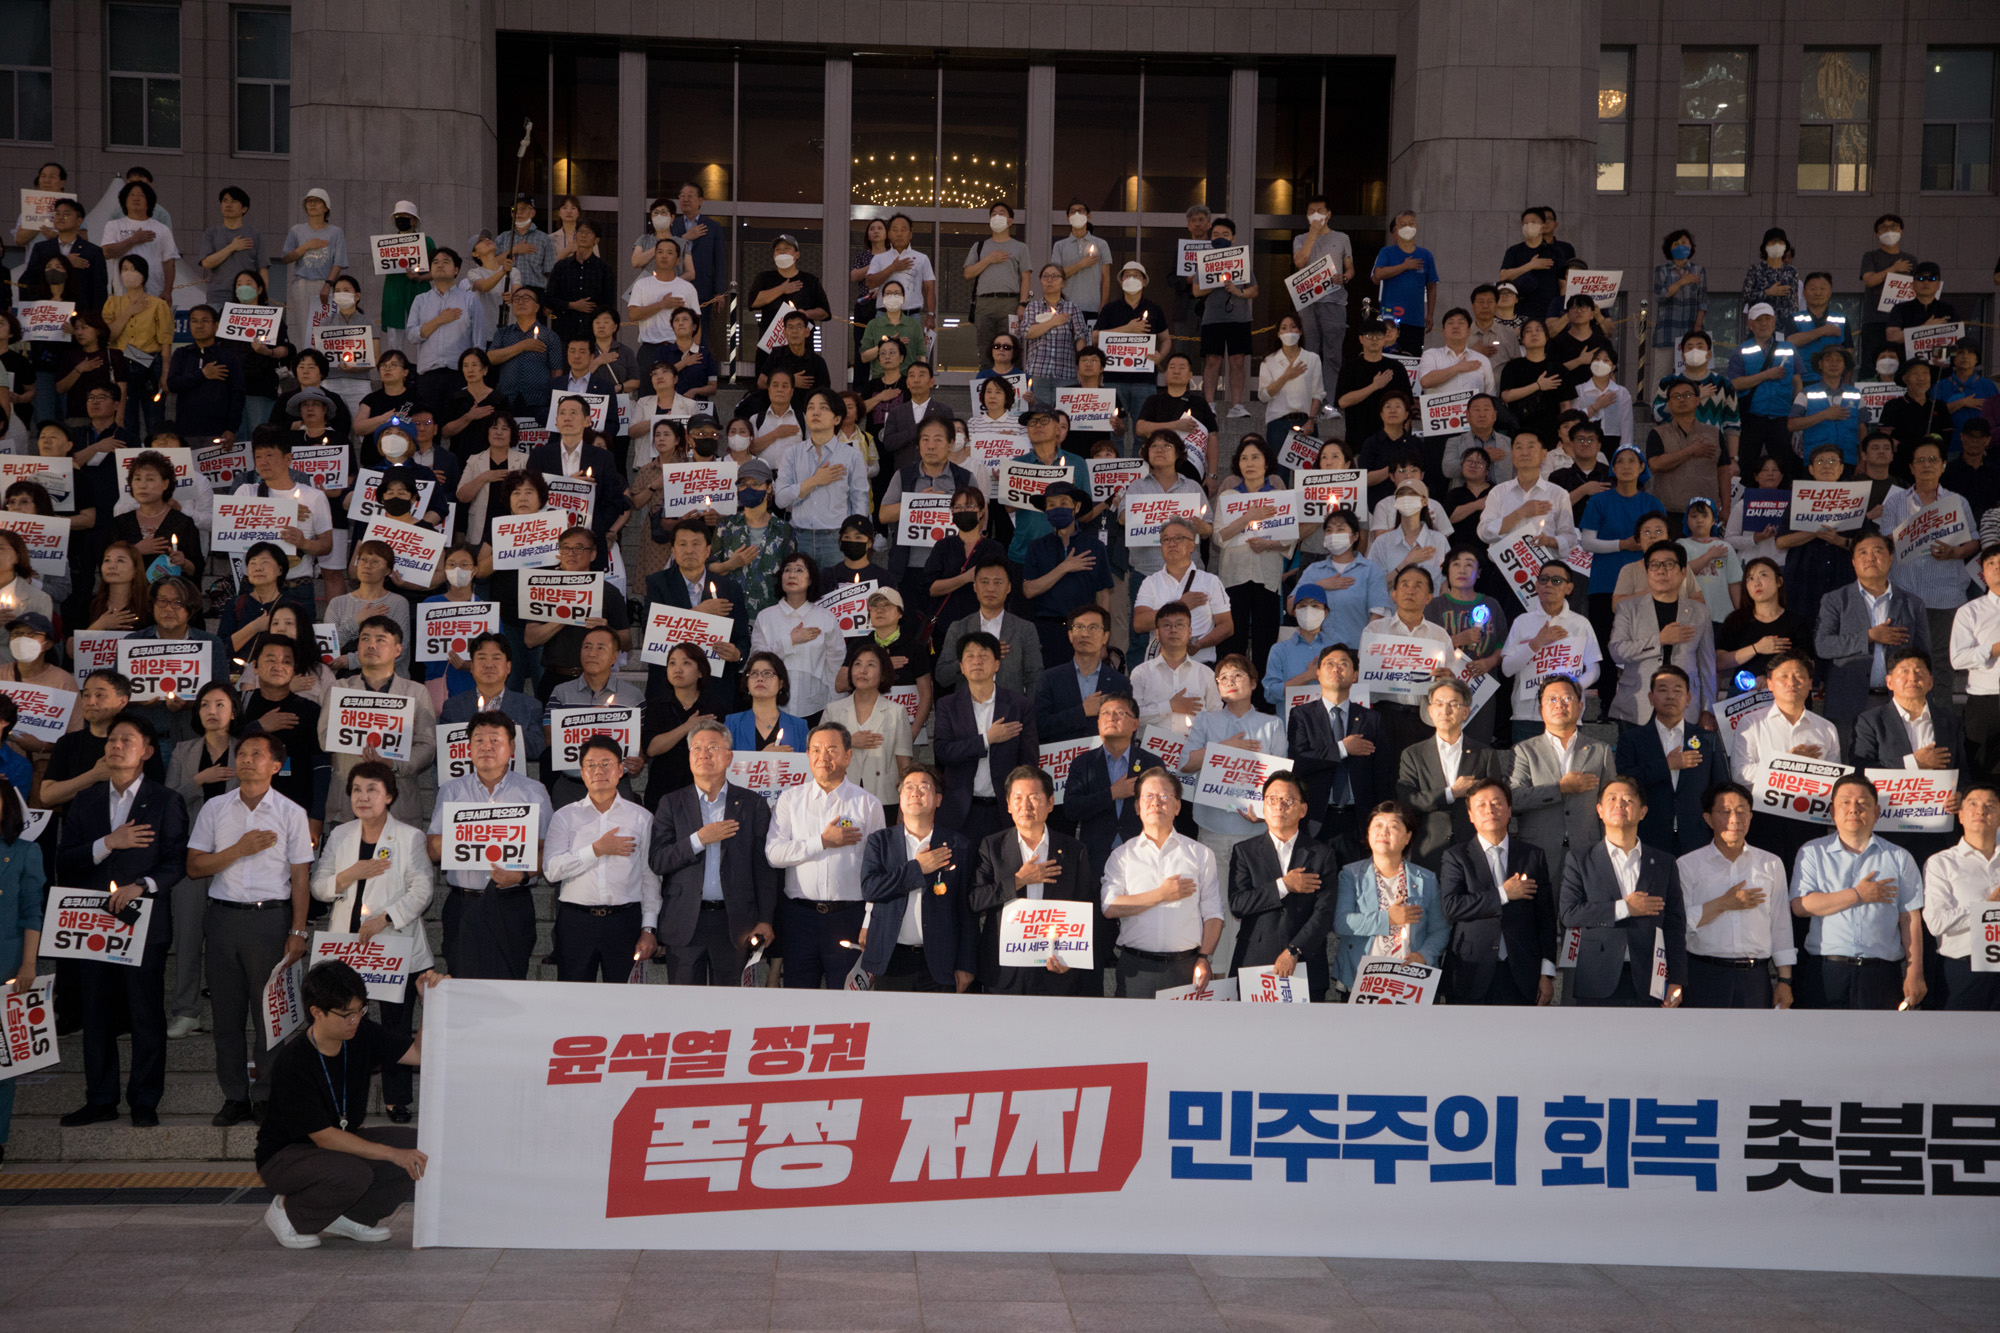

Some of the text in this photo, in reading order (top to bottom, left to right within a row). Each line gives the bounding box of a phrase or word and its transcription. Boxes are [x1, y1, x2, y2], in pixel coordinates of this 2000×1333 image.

[379, 246, 420, 258] 해양투기
[381, 257, 421, 270] STOP!
[1206, 258, 1243, 272] 해양투기
[1206, 269, 1243, 284] STOP!
[1295, 268, 1331, 295] 해양투기
[1571, 275, 1608, 285] 무너지는
[1299, 277, 1334, 304] STOP!
[1580, 283, 1617, 293] 민주주의
[228, 314, 272, 328] 해양투기
[225, 324, 270, 339] STOP!
[323, 339, 366, 350] 해양투기
[1107, 344, 1148, 356] 해양투기
[324, 350, 367, 362] STOP!
[1106, 356, 1147, 368] STOP!
[1060, 393, 1099, 403] 무너지는
[1071, 401, 1112, 412] 민주주의
[1430, 417, 1468, 429] STOP
[518, 430, 549, 443] 해양투
[974, 440, 1013, 450] 무너지는
[1291, 441, 1318, 463] 해양투
[985, 448, 1024, 458] 민주주의
[3, 464, 49, 474] 무너지는
[200, 456, 246, 470] 해양투기
[292, 460, 341, 472] 해양투기
[669, 468, 717, 484] 무너지는
[683, 479, 732, 494] 민주주의
[1305, 486, 1357, 500] 해양투기
[1797, 488, 1850, 500] 무너지는
[547, 492, 588, 510] 해양투기
[670, 497, 686, 506] 다시
[1131, 499, 1180, 513] 무너지는
[1811, 497, 1864, 512] 민주주의
[218, 504, 276, 516] 무너지는
[1796, 509, 1864, 522] 다시 세우겠습니다
[235, 516, 293, 528] 민주주의
[497, 519, 546, 536] 무너지는
[1898, 508, 1938, 541] 무너지는
[1910, 510, 1956, 542] 민주주의
[218, 531, 238, 540] 다시
[371, 524, 423, 542] 무너지는
[513, 527, 560, 546] 민주주의
[1131, 527, 1148, 535] 다시
[20, 536, 61, 547] 주주의
[1901, 522, 1965, 559] 다시 세우겠습니다
[387, 540, 435, 560] 민주주의
[497, 549, 514, 558] 다시
[1513, 541, 1540, 576] 해양투
[530, 575, 592, 585] 후쿠시마 핵오염수
[1500, 549, 1538, 599] STOP!
[529, 587, 592, 604] 해양투기
[428, 606, 487, 618] 후쿠시마 핵오염수
[529, 603, 592, 619] STOP!
[427, 621, 488, 636] 해양투기
[653, 614, 709, 632] 무너지는
[666, 630, 724, 647] 민주주의
[131, 644, 198, 657] 후쿠시마 핵오염수
[648, 642, 667, 653] 다시
[130, 659, 199, 675] 해양투기
[1383, 656, 1438, 669] 민주주의
[1537, 656, 1582, 673] 민주주의
[1366, 671, 1386, 679] 다시
[131, 676, 198, 693] STOP!
[342, 698, 402, 708] 후쿠시마 핵오염수
[340, 710, 402, 732] 해양투기
[565, 712, 629, 726] 후쿠시마 핵오염수
[338, 729, 401, 751] STOP!
[732, 760, 790, 774] 무너지는
[1208, 754, 1267, 771] 무너지는
[1772, 760, 1841, 776] 후쿠시마 핵오염수
[749, 773, 806, 788] 민주주의
[1223, 770, 1266, 788] 민주주
[1872, 778, 1934, 792] 무너지는
[1202, 782, 1224, 794] 다시
[1764, 790, 1831, 818] STOP!
[1889, 790, 1952, 806] 민주주의
[457, 808, 525, 821] 후쿠시마 핵오염수
[456, 825, 525, 842] 해양투기
[455, 844, 525, 863] STOP!
[62, 897, 102, 907] 후쿠시마
[59, 911, 134, 936] 해양투기
[1023, 924, 1085, 939] 민주주의
[54, 931, 132, 956] STOP!
[318, 942, 385, 955] 무너지는
[1006, 943, 1026, 952] 다시
[338, 956, 403, 971] 민주주의
[1366, 964, 1427, 978] 후쿠시마 핵오염수
[1359, 976, 1423, 1004] 해양투기
[268, 984, 282, 1037] 무너지는
[7, 992, 31, 1062] 해양투기
[26, 988, 50, 1056] STOP!
[547, 1022, 870, 1085] 윤석열 정권
[644, 1086, 1112, 1192] 폭정 저지
[1168, 1090, 1518, 1185] 민주주의
[1542, 1095, 1720, 1191] 회복
